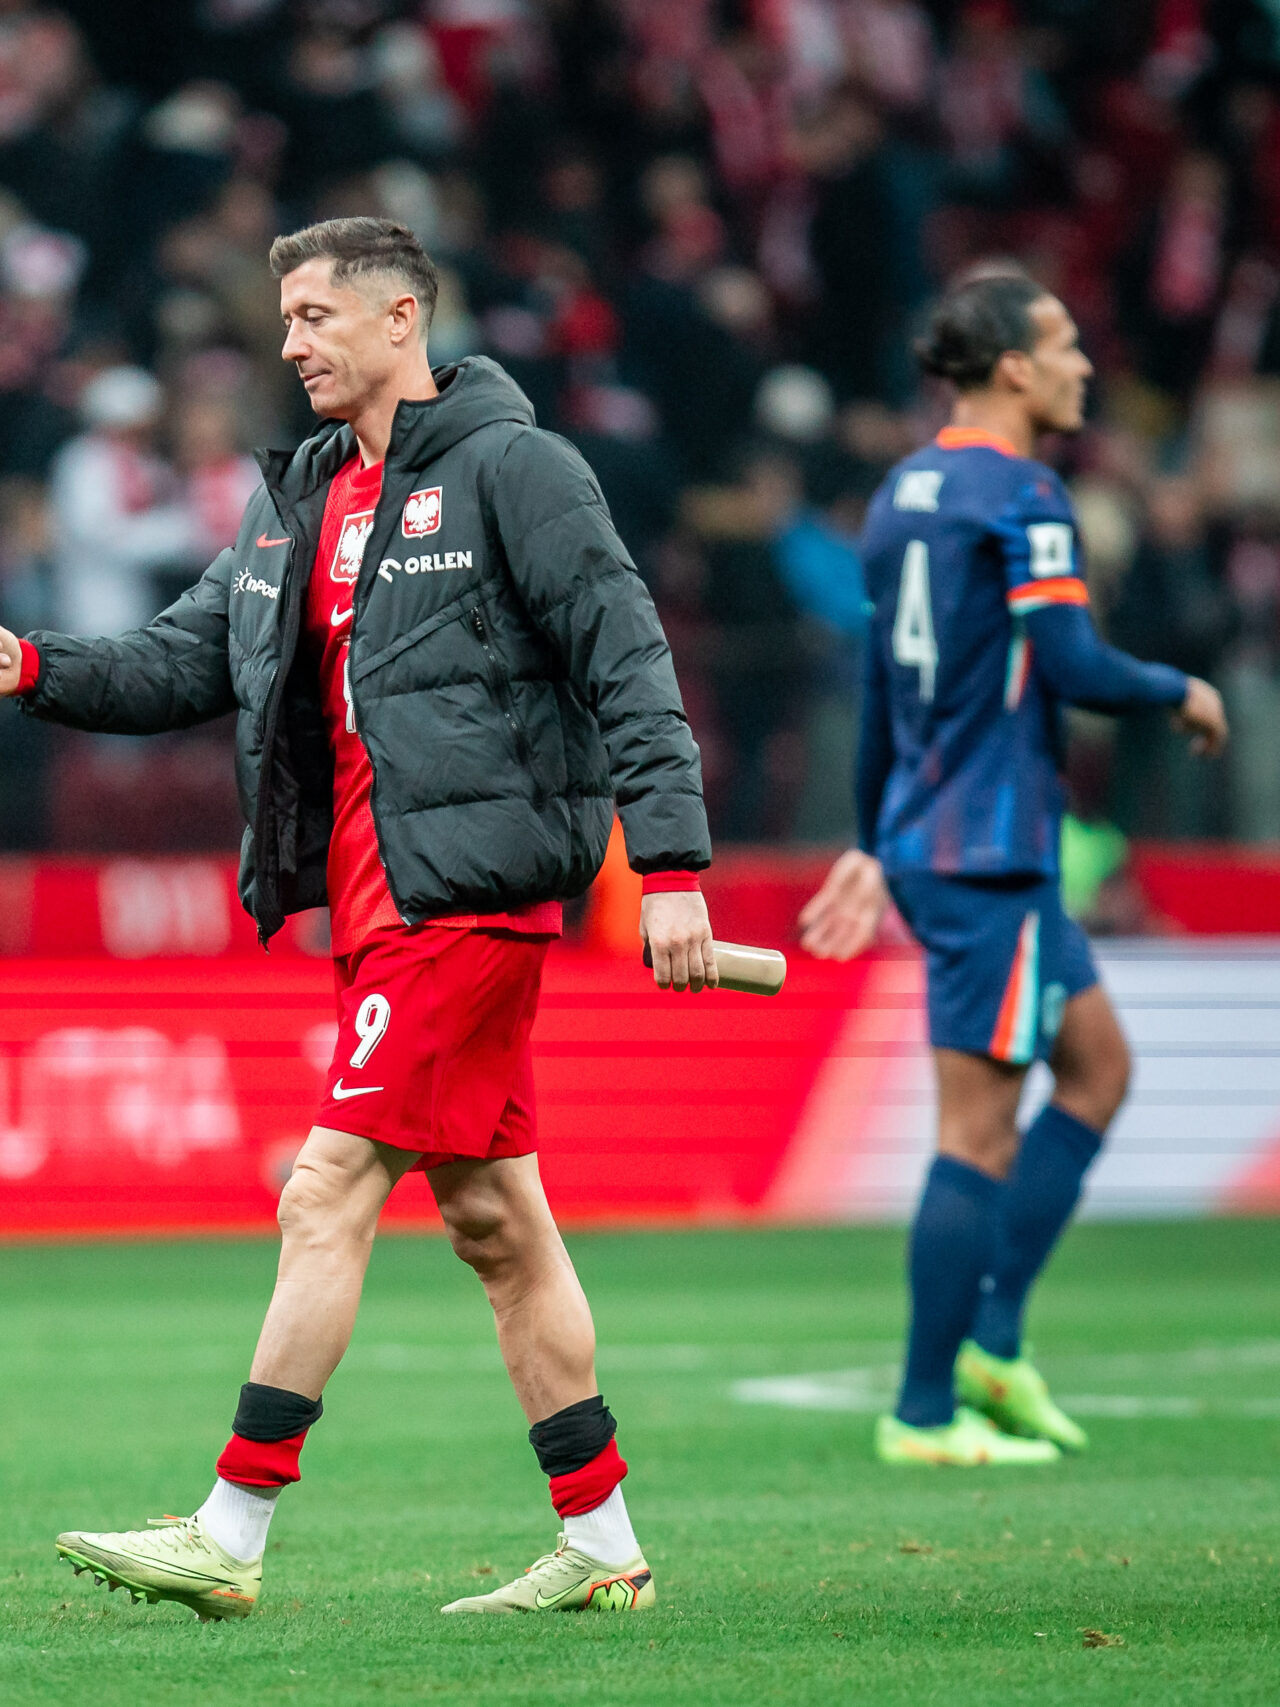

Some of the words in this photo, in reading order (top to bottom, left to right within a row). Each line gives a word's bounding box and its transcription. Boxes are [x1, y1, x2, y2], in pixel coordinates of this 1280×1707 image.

[404, 550, 473, 575] ORLEN
[892, 539, 939, 703] 4
[349, 993, 391, 1069] 9
